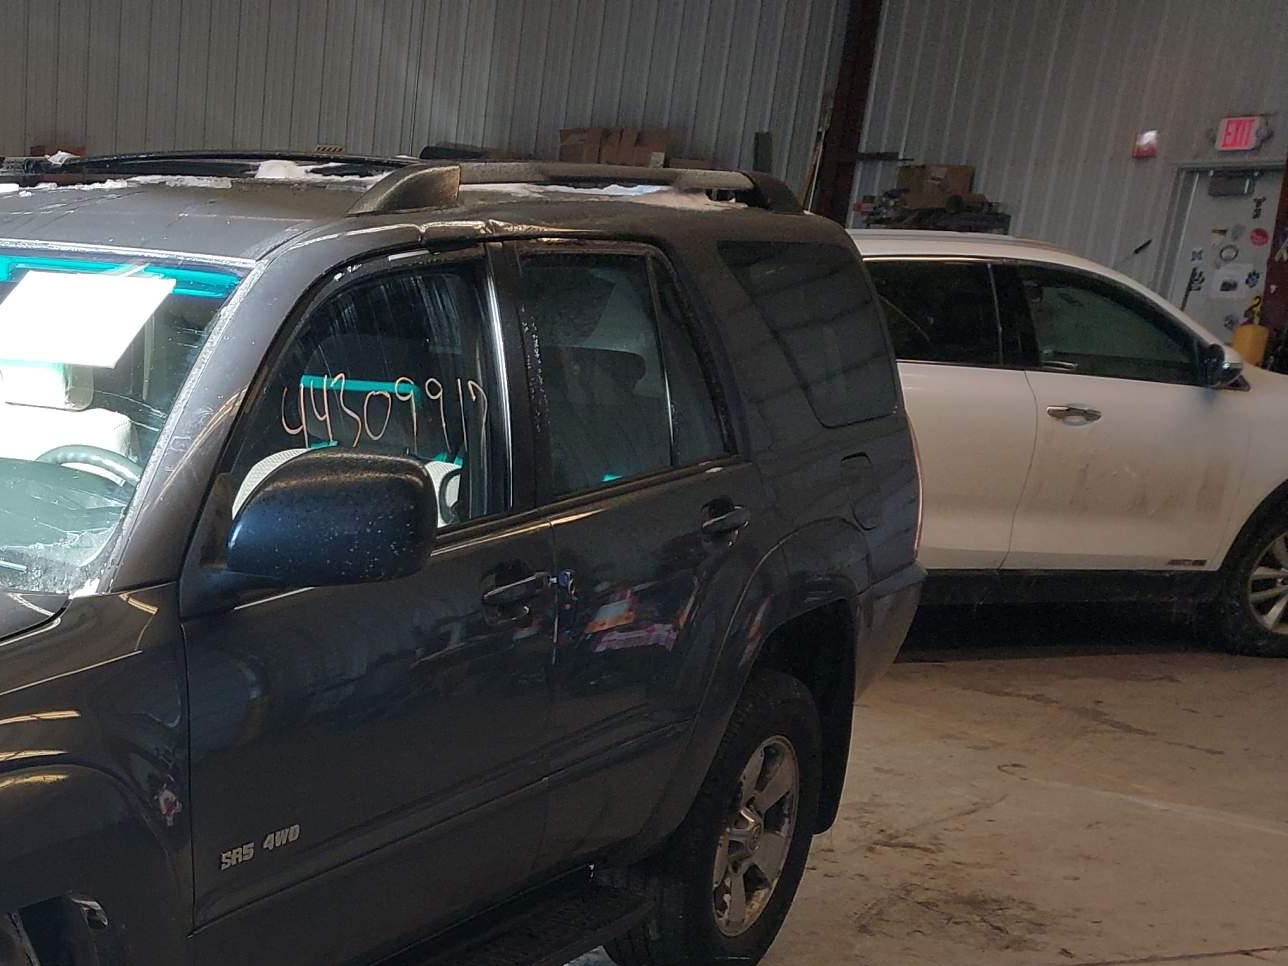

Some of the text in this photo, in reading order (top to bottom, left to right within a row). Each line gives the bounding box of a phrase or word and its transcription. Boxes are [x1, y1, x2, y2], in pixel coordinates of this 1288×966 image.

[1223, 119, 1256, 148] EXIT
[282, 373, 489, 455] 44309917
[221, 824, 300, 870] SR5 4WD
